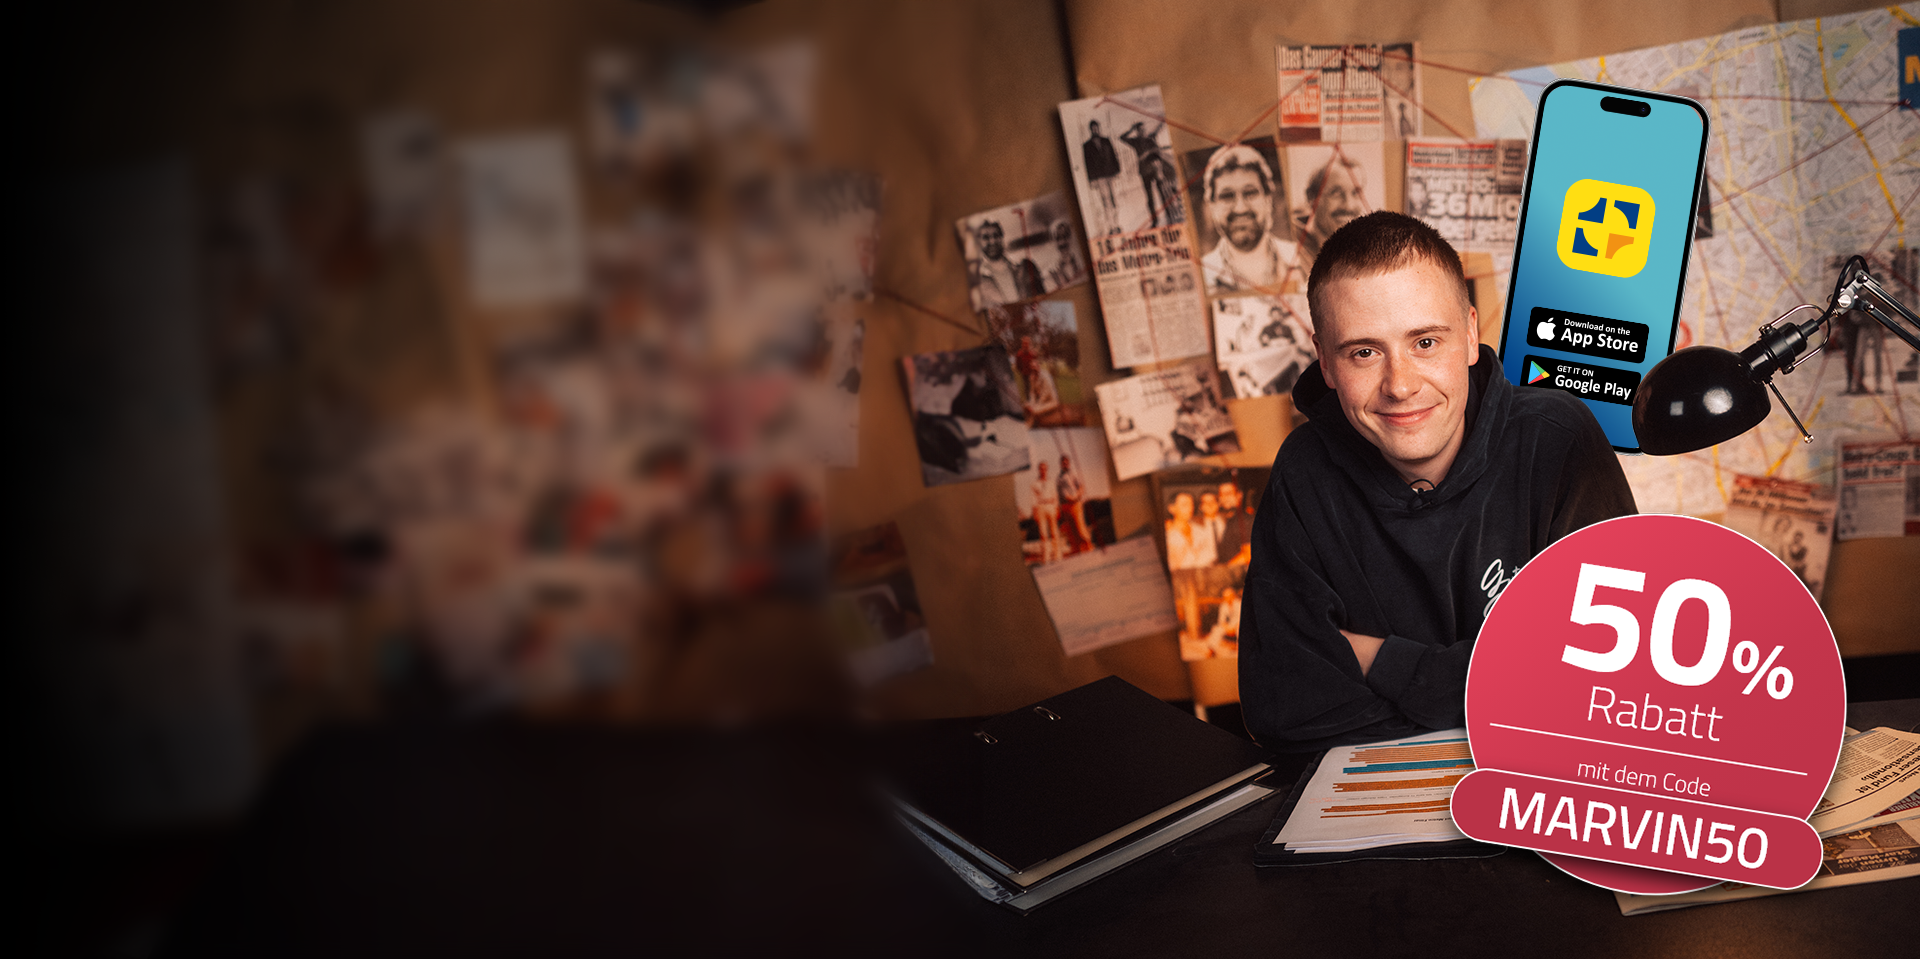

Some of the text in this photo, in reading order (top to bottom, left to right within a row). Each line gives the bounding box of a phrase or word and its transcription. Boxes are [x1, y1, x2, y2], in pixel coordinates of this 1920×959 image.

[1426, 192, 1468, 219] 36
[1564, 318, 1604, 331] Download
[1617, 327, 1631, 336] the
[1560, 328, 1639, 352] App Store
[1557, 365, 1594, 377] GET IT ON
[1555, 375, 1632, 401] Google Play
[1871, 771, 1900, 788] Fund
[1855, 784, 1875, 794] ist
[1838, 849, 1911, 864] Star-Magier
